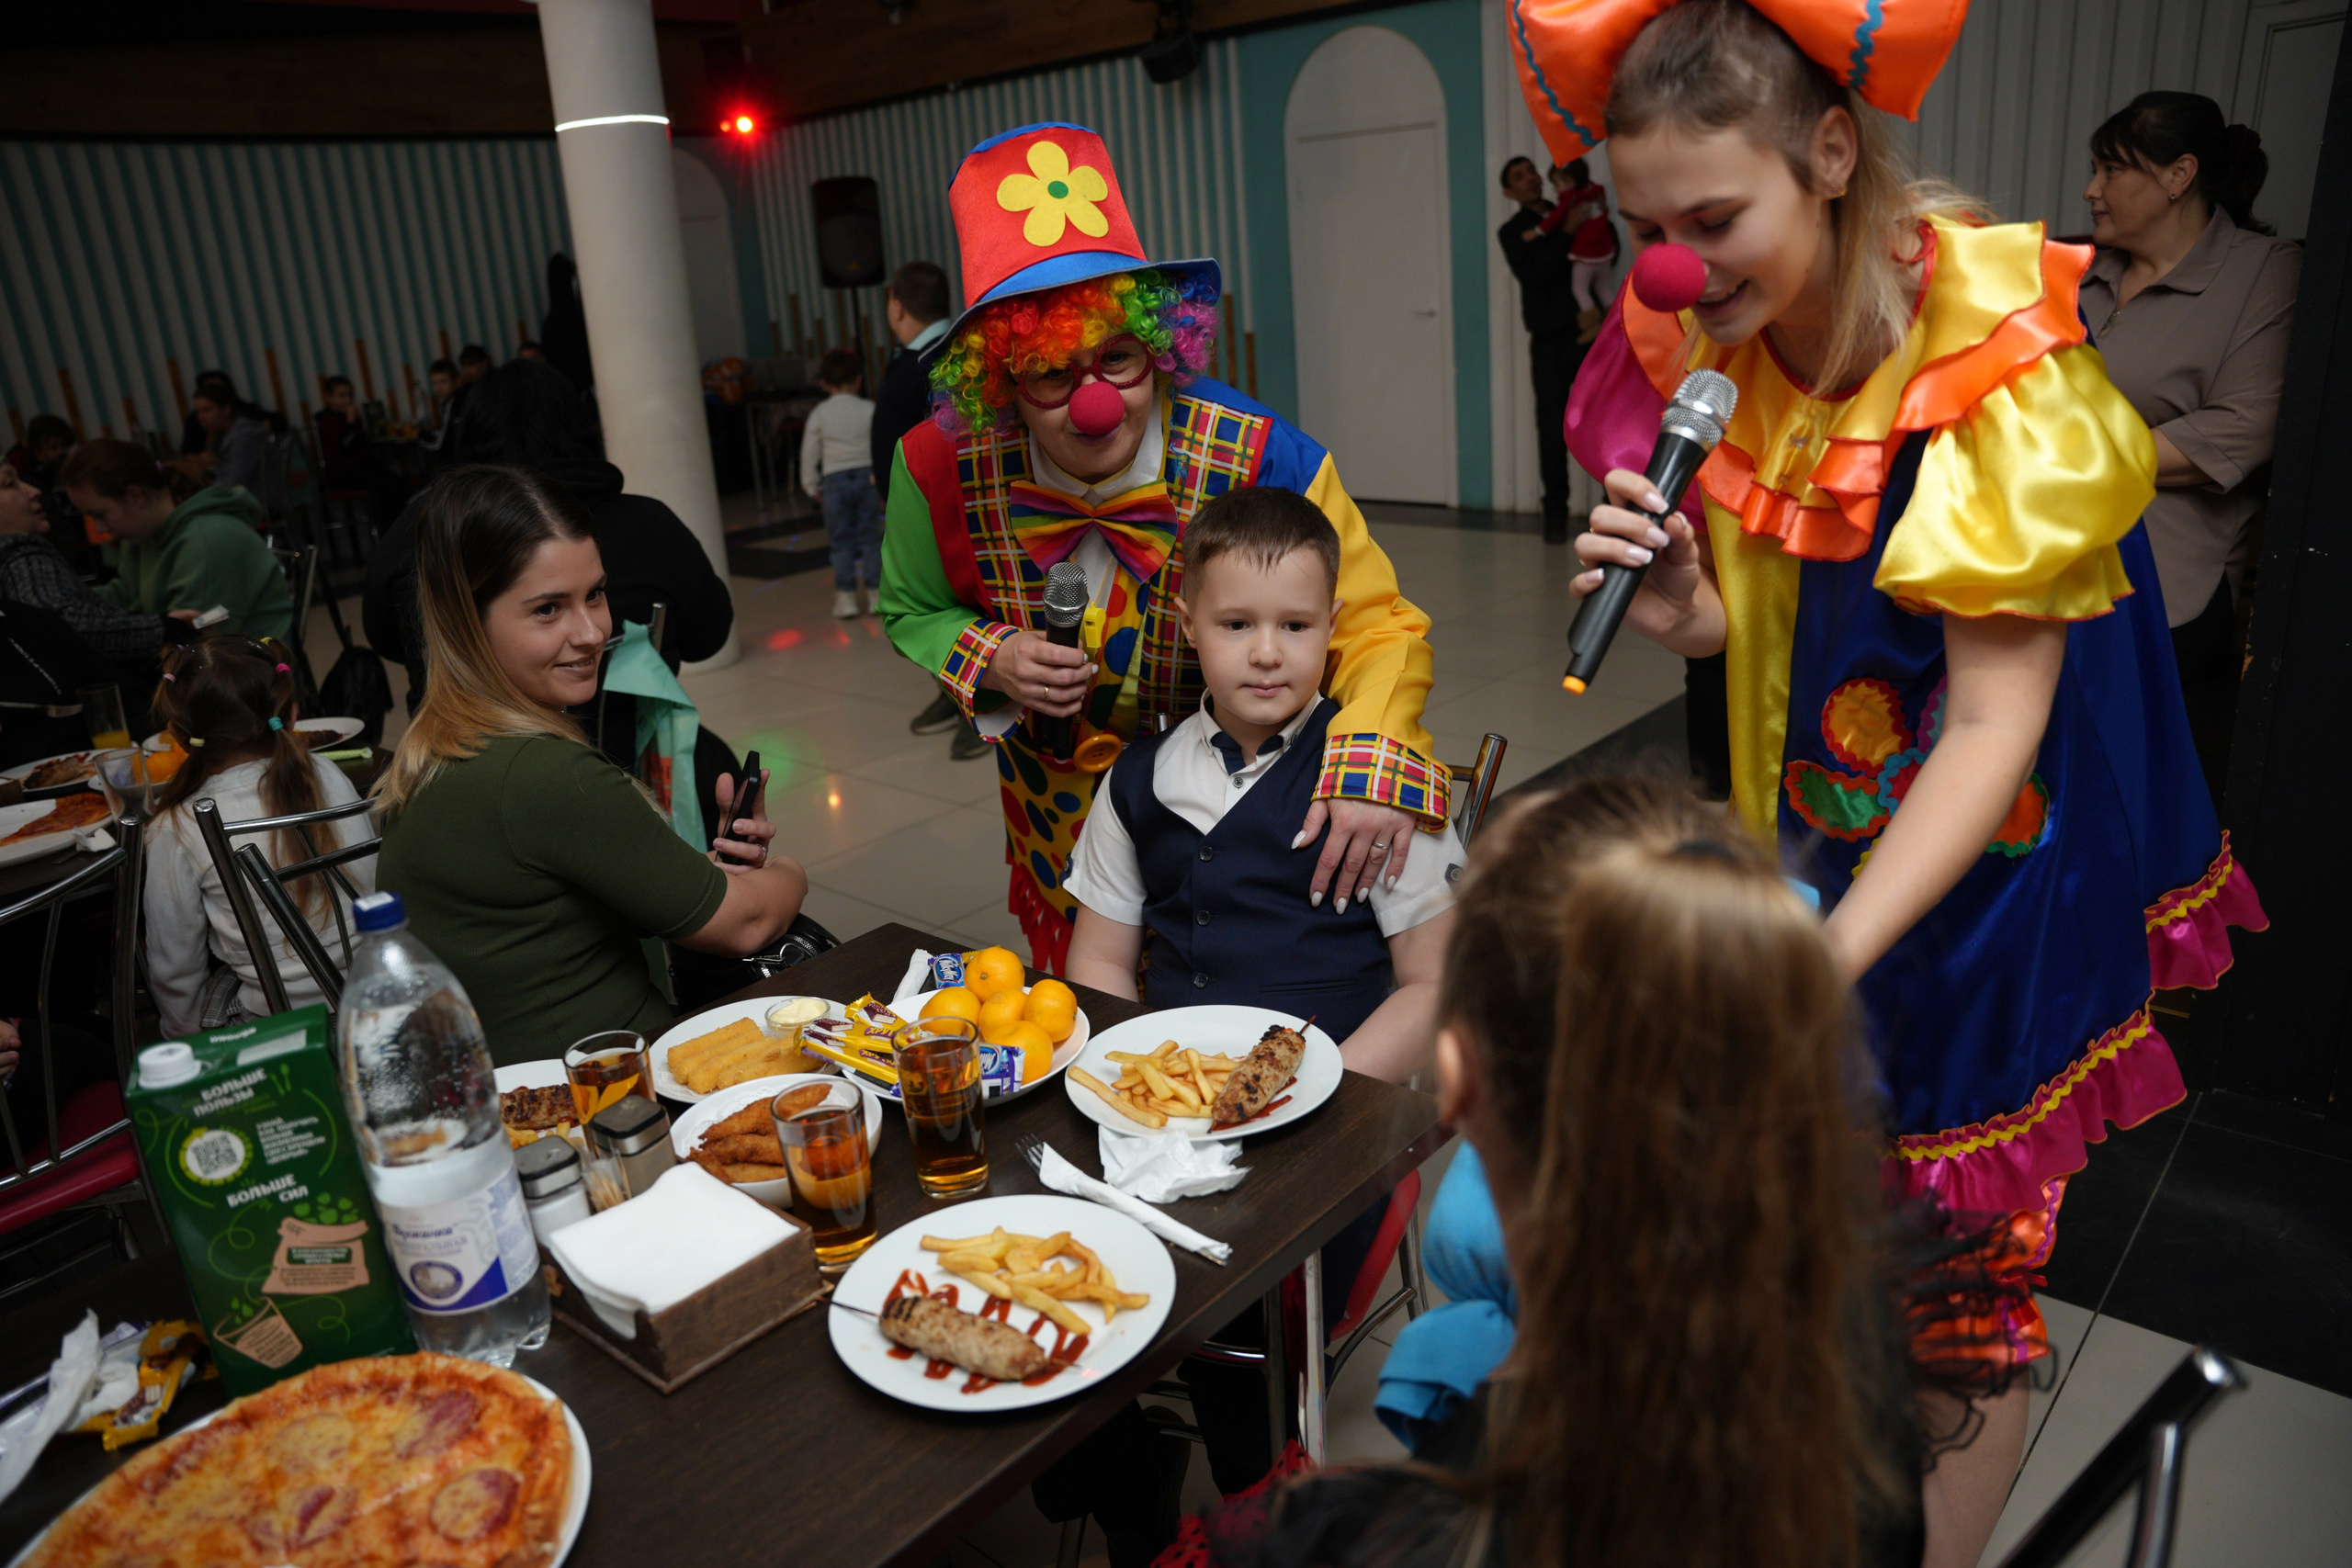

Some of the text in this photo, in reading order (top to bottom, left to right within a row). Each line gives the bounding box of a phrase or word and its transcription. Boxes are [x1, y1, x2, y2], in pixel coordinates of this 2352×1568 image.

[200, 1068, 267, 1101] БОЛЬШЕ
[193, 1088, 254, 1116] ПОЛЬЗЫ
[227, 1174, 297, 1208] БОЛЬШЕ
[278, 1185, 309, 1203] СИЛ
